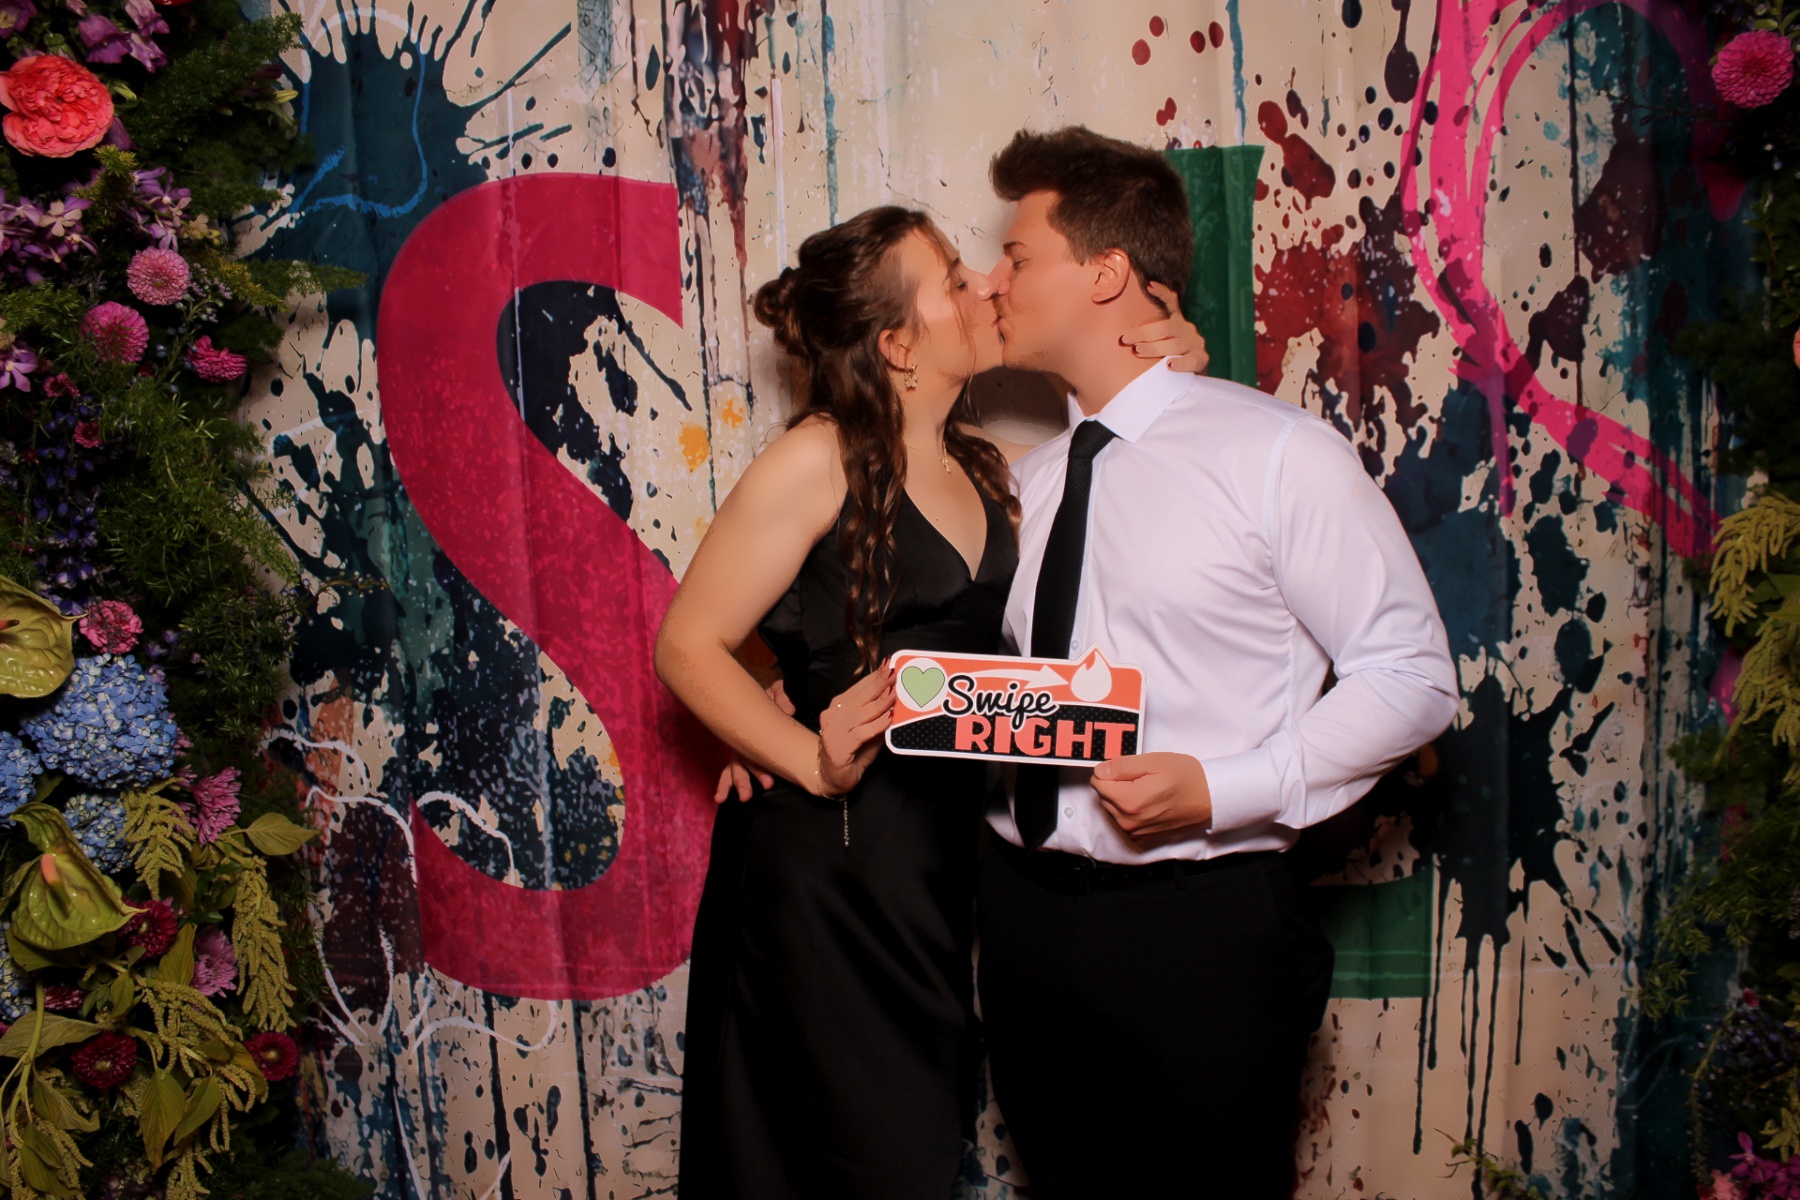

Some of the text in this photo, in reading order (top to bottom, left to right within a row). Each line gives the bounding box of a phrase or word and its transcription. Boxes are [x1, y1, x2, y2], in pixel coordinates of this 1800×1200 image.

[377, 173, 729, 1000] S
[943, 675, 1057, 730] Swipe
[955, 716, 1136, 760] RIGHT
